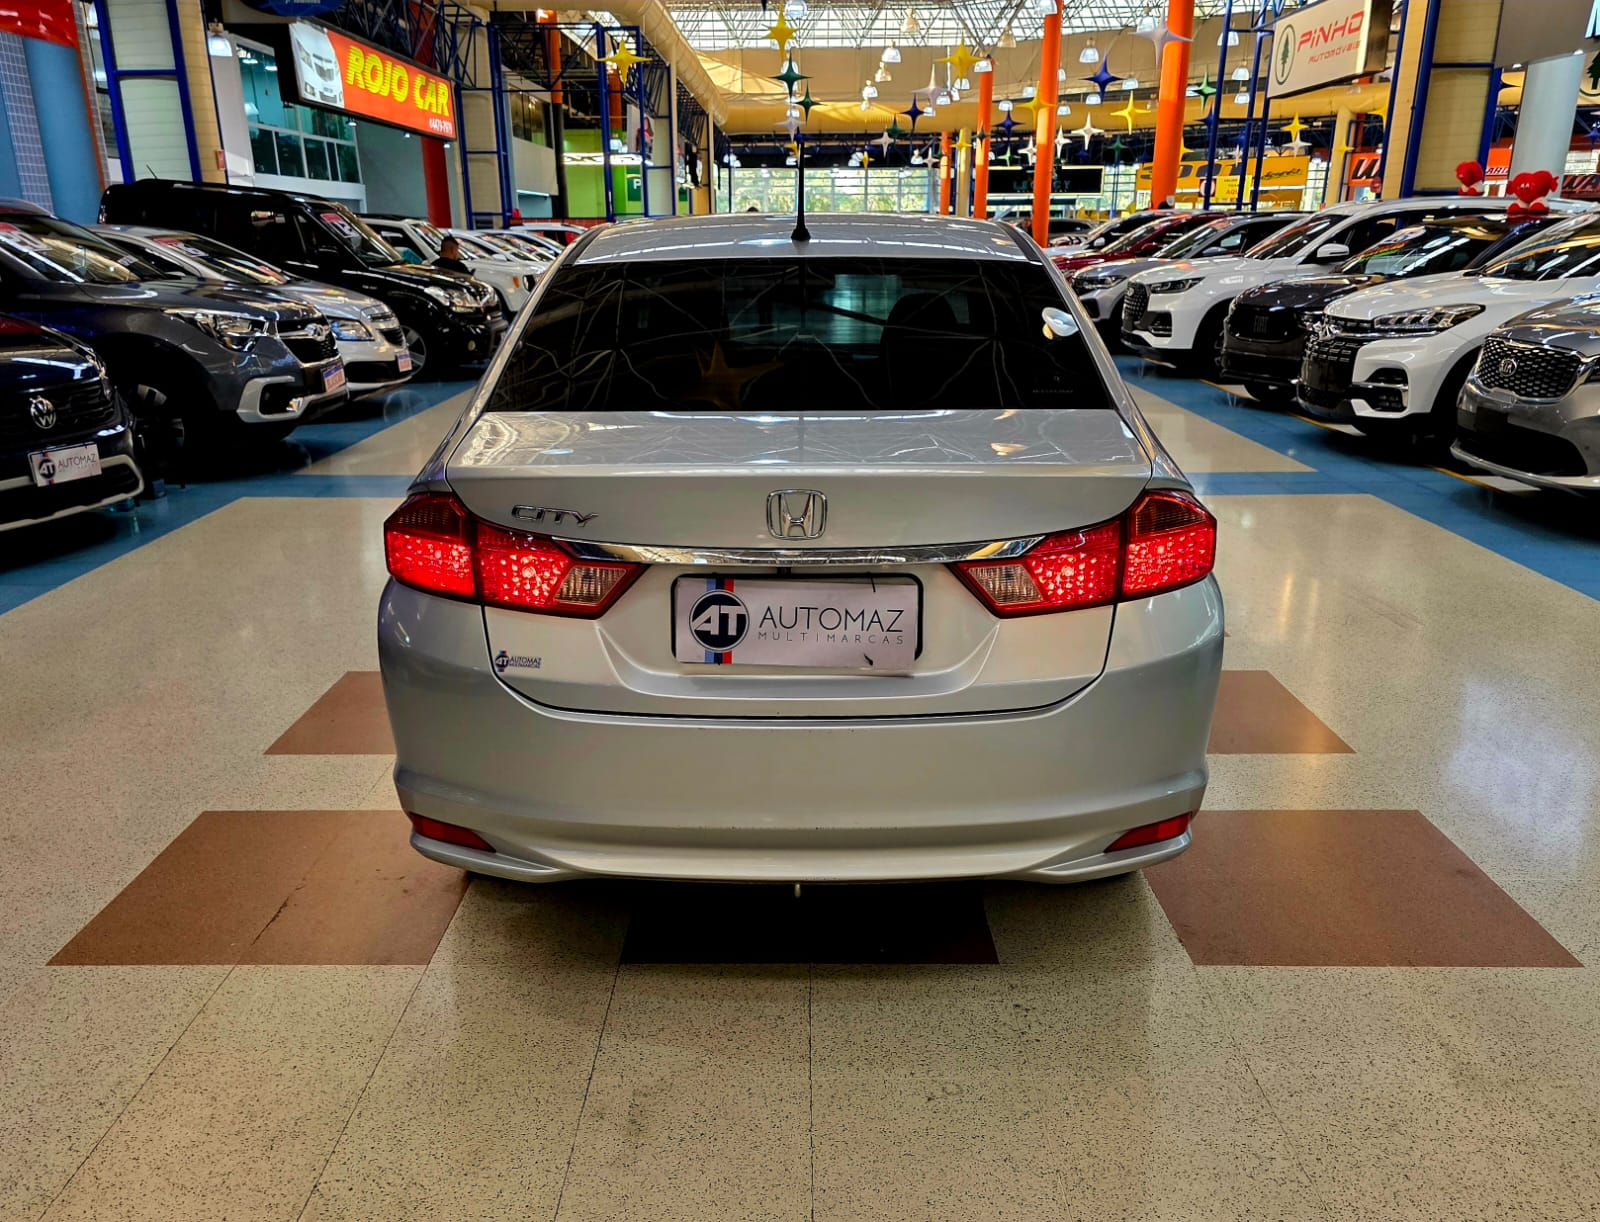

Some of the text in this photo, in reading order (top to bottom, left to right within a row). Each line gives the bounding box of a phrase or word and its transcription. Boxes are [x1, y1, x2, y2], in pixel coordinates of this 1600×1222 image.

[1297, 10, 1364, 53] PINHO
[345, 44, 450, 118] ROJO CAR
[57, 453, 97, 469] AUTOMAZ
[511, 504, 600, 528] CITY
[692, 604, 904, 636] AT AUTOMAZ
[757, 631, 904, 645] MULTIMARCAS
[509, 656, 542, 665] AUTOMAZ
